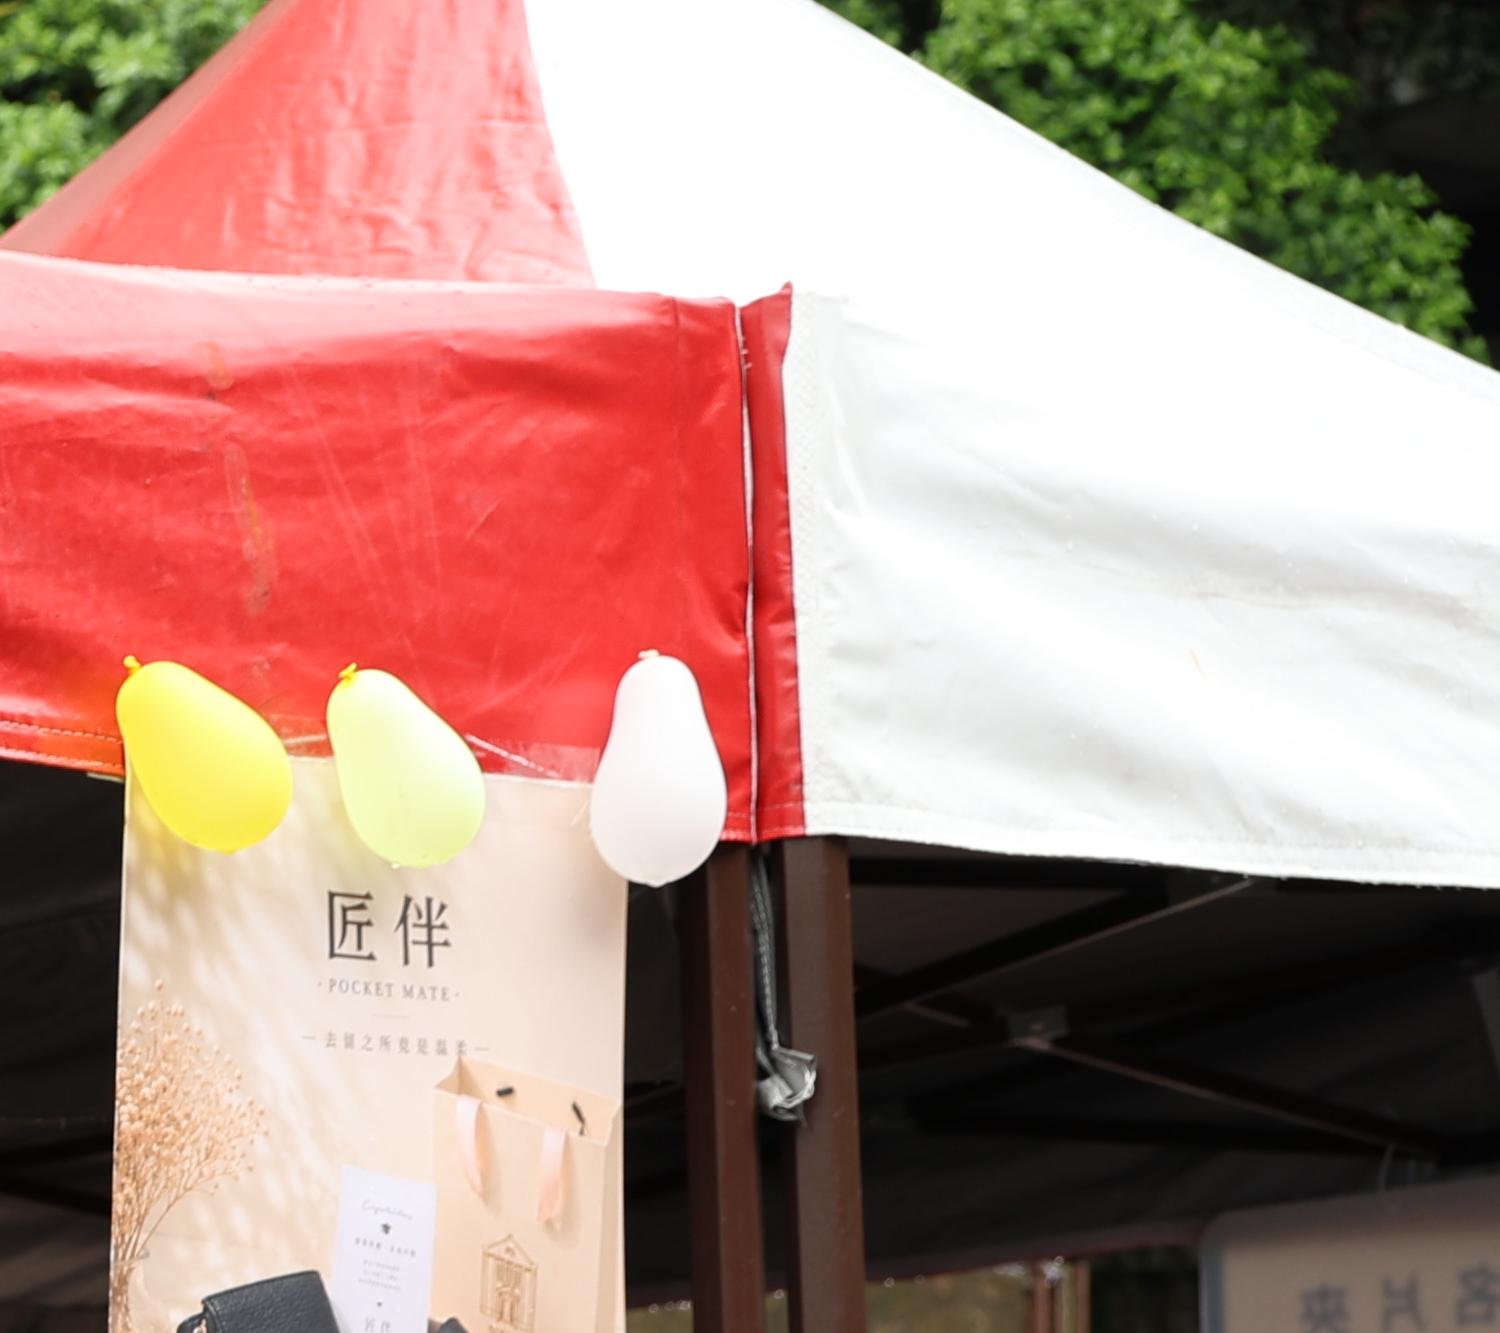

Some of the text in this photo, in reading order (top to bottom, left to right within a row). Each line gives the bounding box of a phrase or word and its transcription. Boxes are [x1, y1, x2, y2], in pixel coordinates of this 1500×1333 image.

[326, 889, 452, 968] 匠伴
[328, 978, 451, 1002] POCKET MATE
